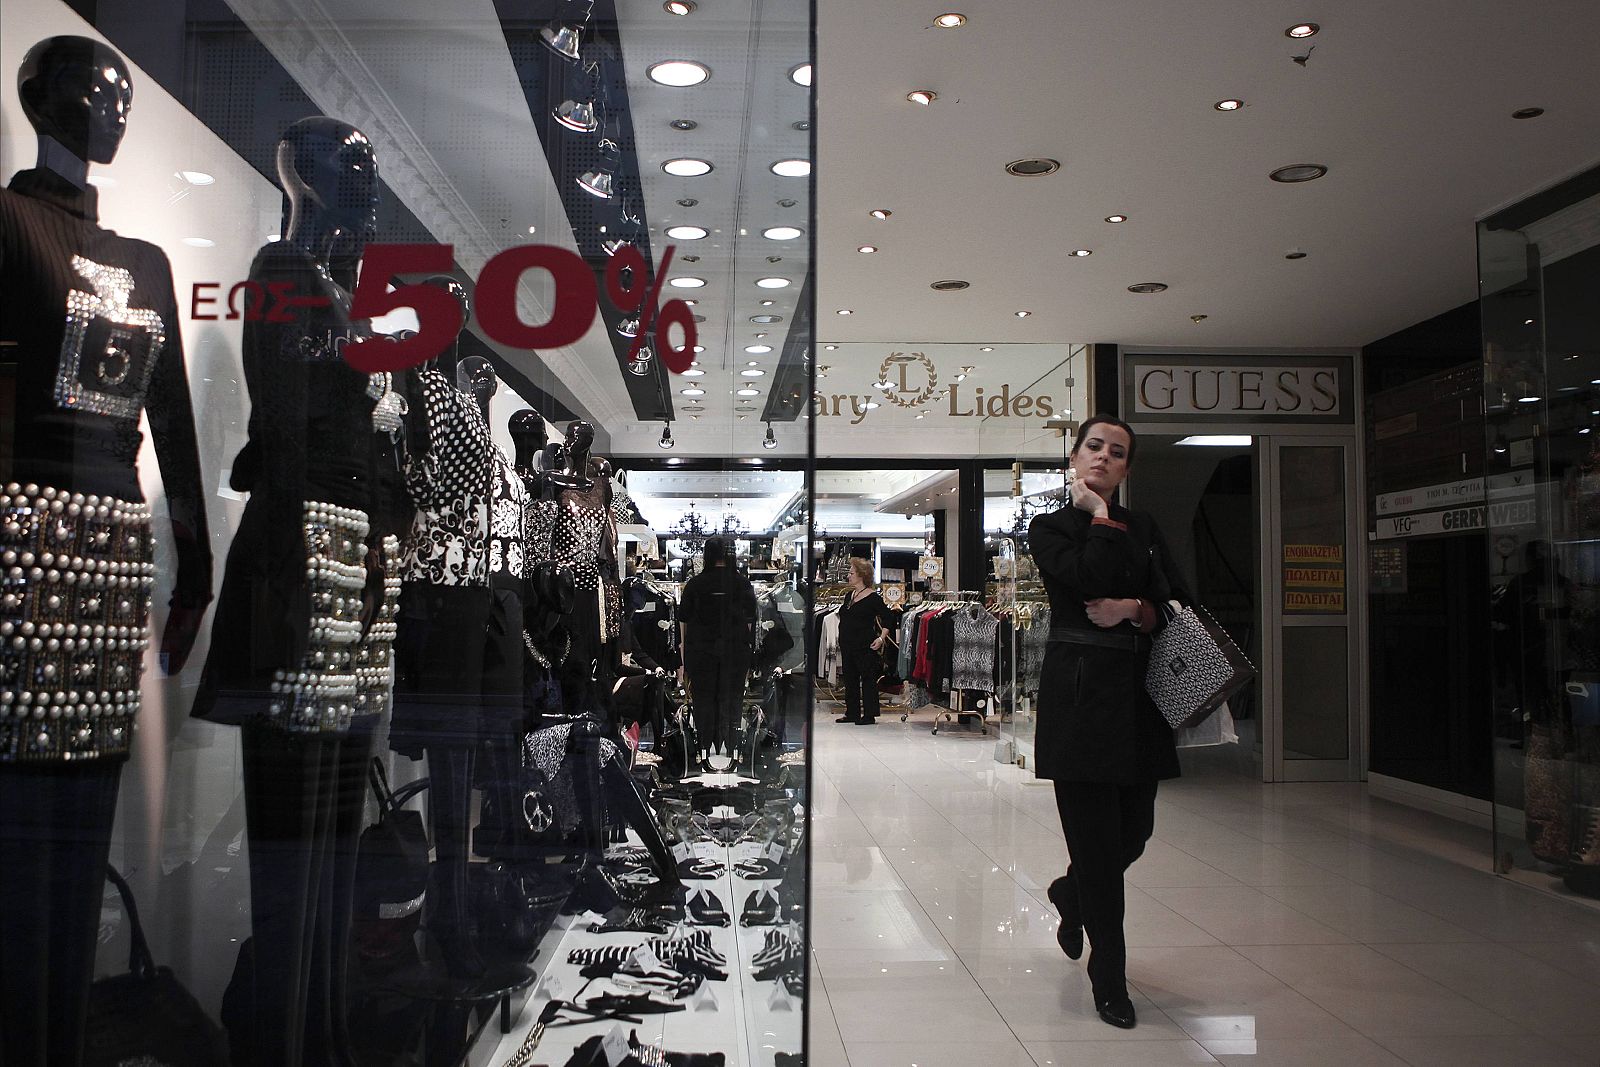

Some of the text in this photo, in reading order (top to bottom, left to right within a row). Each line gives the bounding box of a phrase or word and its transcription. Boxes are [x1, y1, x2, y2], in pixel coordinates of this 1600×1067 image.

[1138, 369, 1337, 413] GUESS
[948, 383, 1054, 418] Lides
[1393, 517, 1411, 532] VFG
[1442, 507, 1485, 530] GERRY
[1285, 546, 1340, 558] ΕΝΟΙΚΙΑΖΕΤΑΙ
[1285, 570, 1340, 582] ΠΩΛΕΙΤΑΙ
[1286, 593, 1341, 605] ΠΩΛΕΙΤΑΙ
